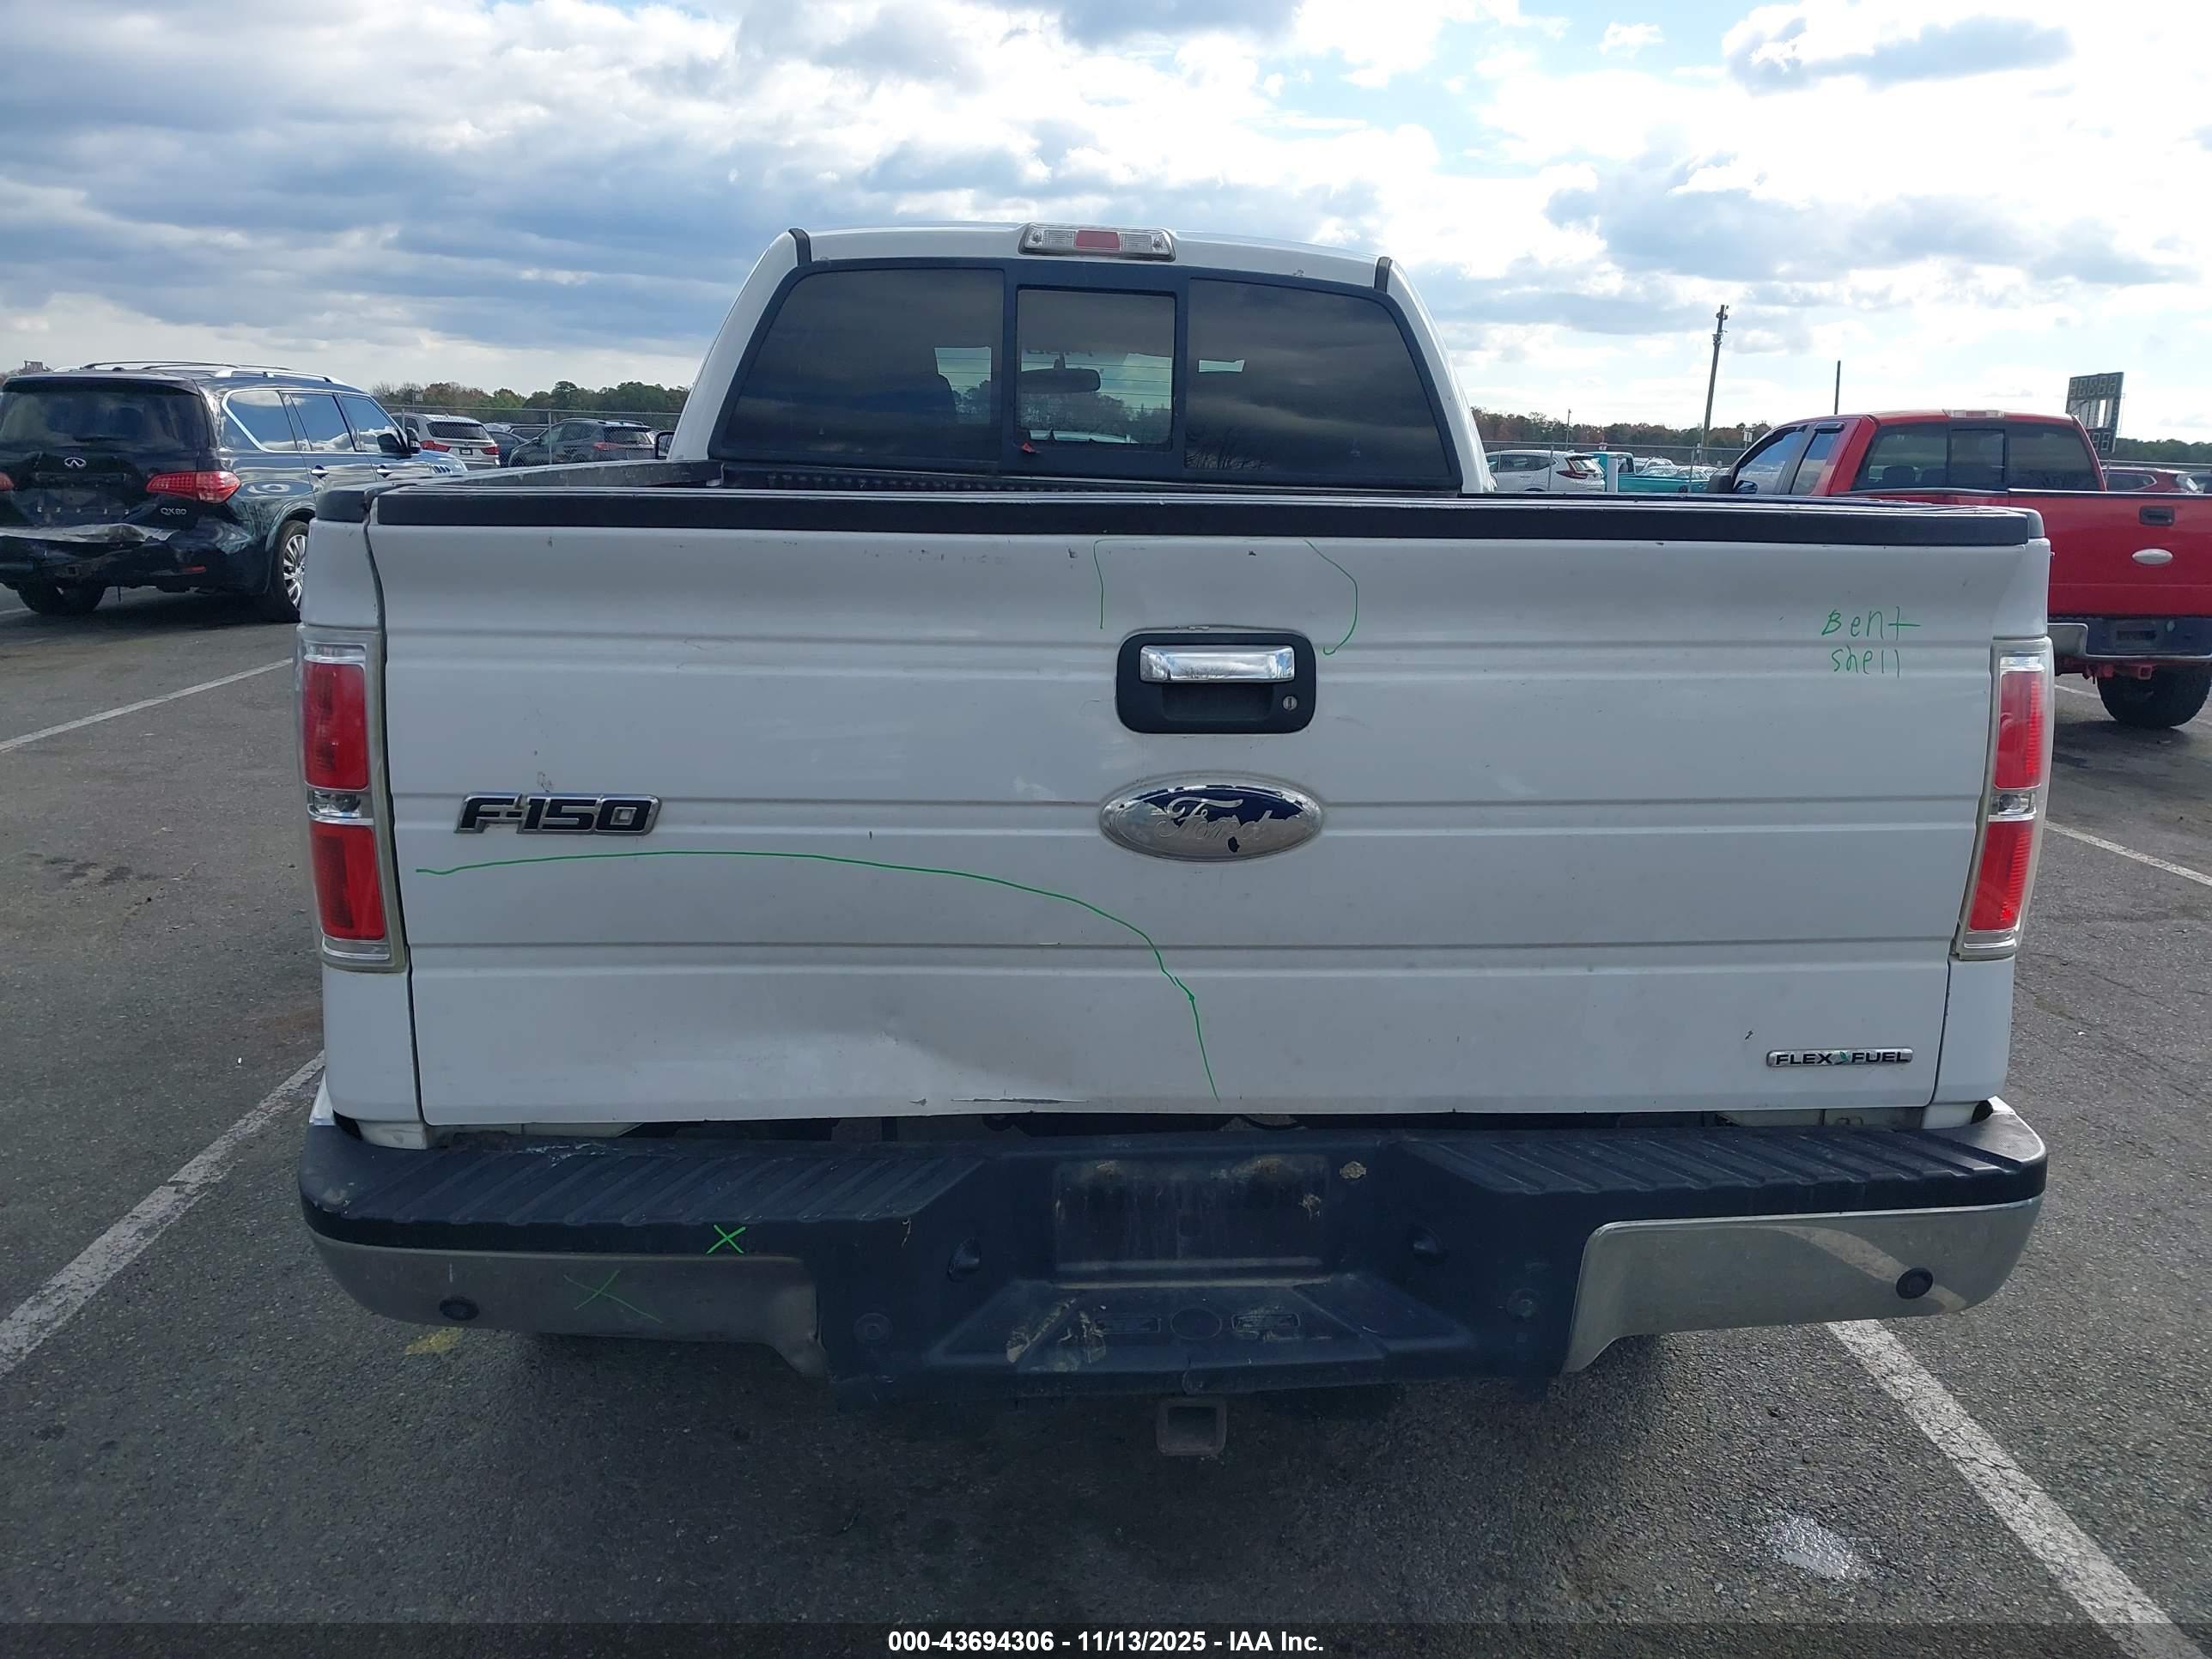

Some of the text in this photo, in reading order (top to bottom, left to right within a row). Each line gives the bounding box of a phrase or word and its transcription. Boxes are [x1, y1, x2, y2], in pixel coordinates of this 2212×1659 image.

[160, 507, 187, 516] QX80
[1820, 605, 1922, 641] Bent
[453, 792, 663, 836] F-150
[1775, 1050, 1910, 1066] FLEX FUEL
